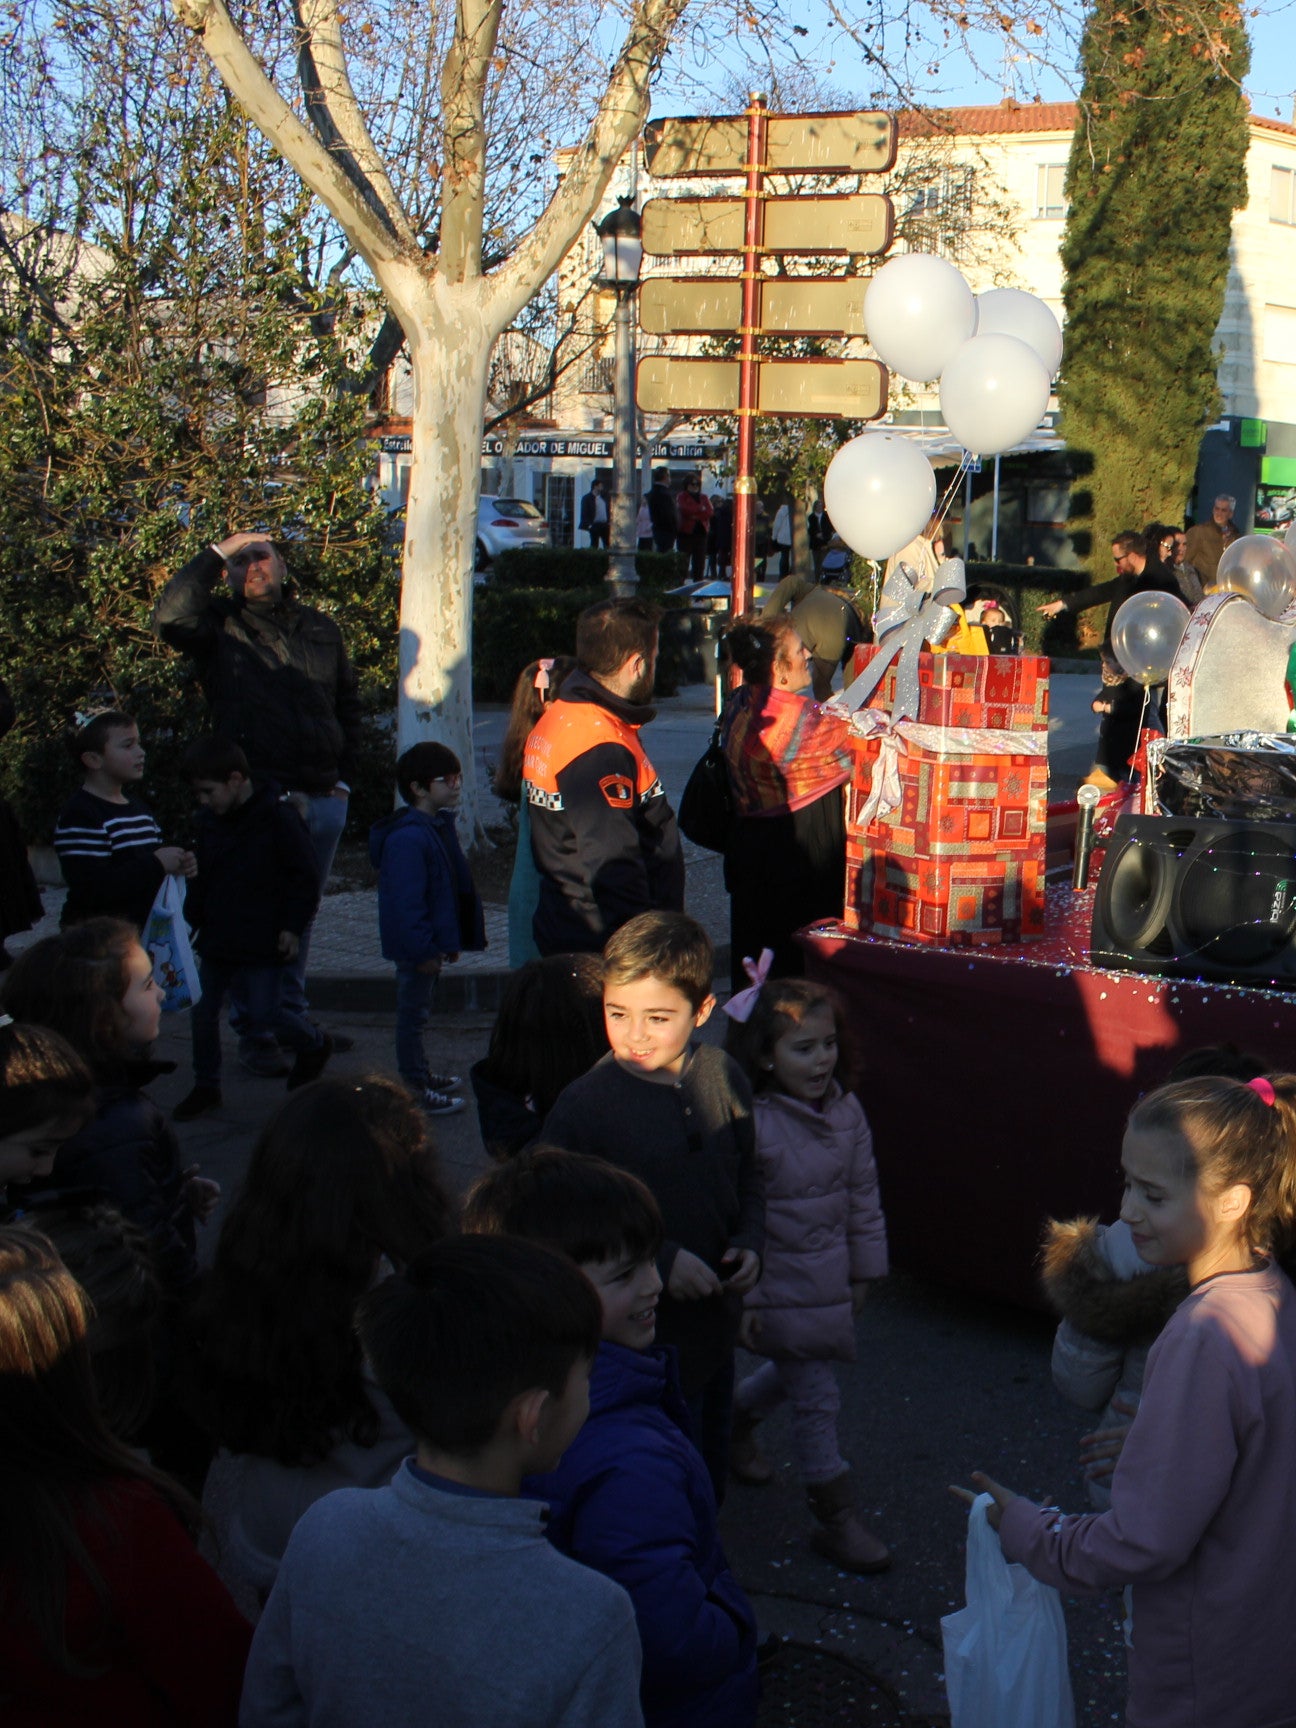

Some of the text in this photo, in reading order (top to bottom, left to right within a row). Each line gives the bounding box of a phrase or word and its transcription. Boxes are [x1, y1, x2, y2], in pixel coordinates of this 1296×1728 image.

[494, 441, 547, 454] OADOR
[550, 441, 565, 454] DE
[567, 442, 609, 455] MIGUEL
